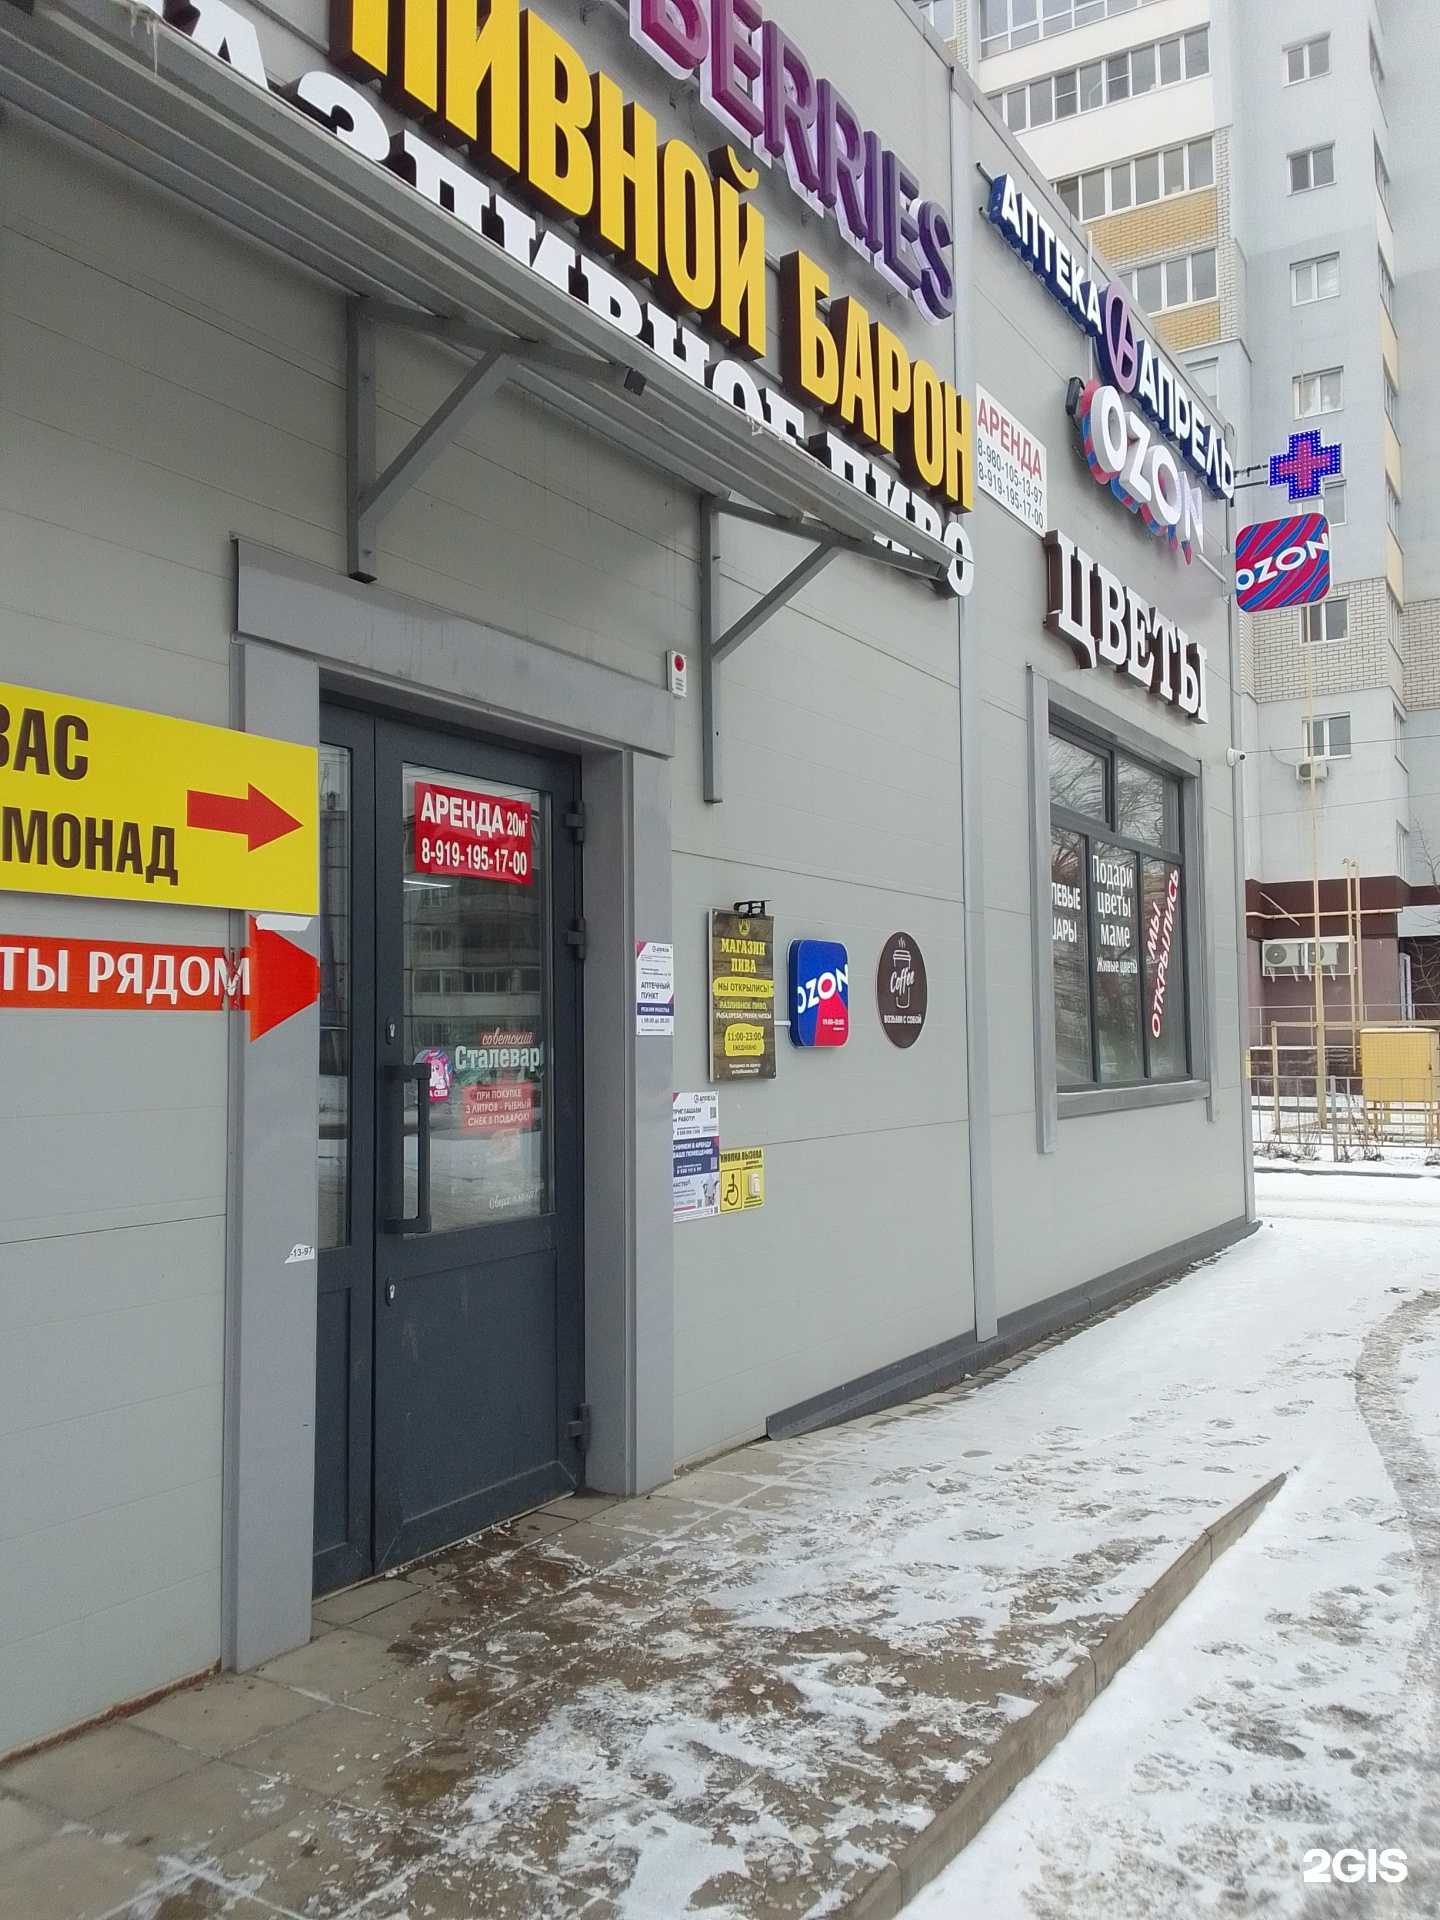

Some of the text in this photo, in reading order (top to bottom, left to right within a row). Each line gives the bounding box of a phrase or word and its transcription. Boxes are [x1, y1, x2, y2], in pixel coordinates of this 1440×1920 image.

[1001, 174, 1234, 499] АПТЕКА АПРЕЛЬ
[799, 250, 972, 512] БАРОН
[978, 398, 1042, 481] АРЕНДА
[1091, 385, 1204, 552] OZON
[978, 438, 1043, 506] 8-980-105-13-97
[978, 462, 1044, 529] 8-919-195-17-00
[1236, 532, 1329, 591] OZON
[1058, 529, 1208, 724] ЦВЕТЫ
[421, 792, 505, 838] АРЕНДА
[2, 806, 179, 887] МОНАД
[422, 837, 527, 876] 8-919-195-17-00
[1093, 855, 1133, 894] Подари
[1097, 891, 1131, 919] цветы
[1147, 901, 1162, 960] МЫ
[721, 937, 766, 955] МАГАЗИН
[1100, 923, 1131, 948] маме
[1151, 869, 1179, 1039] ОТКРЫЛИСЬ
[89, 950, 250, 1005] РЯДОМ
[731, 958, 757, 973] ПИВА
[890, 967, 915, 996] Coffee
[455, 1045, 540, 1072] Сталевар
